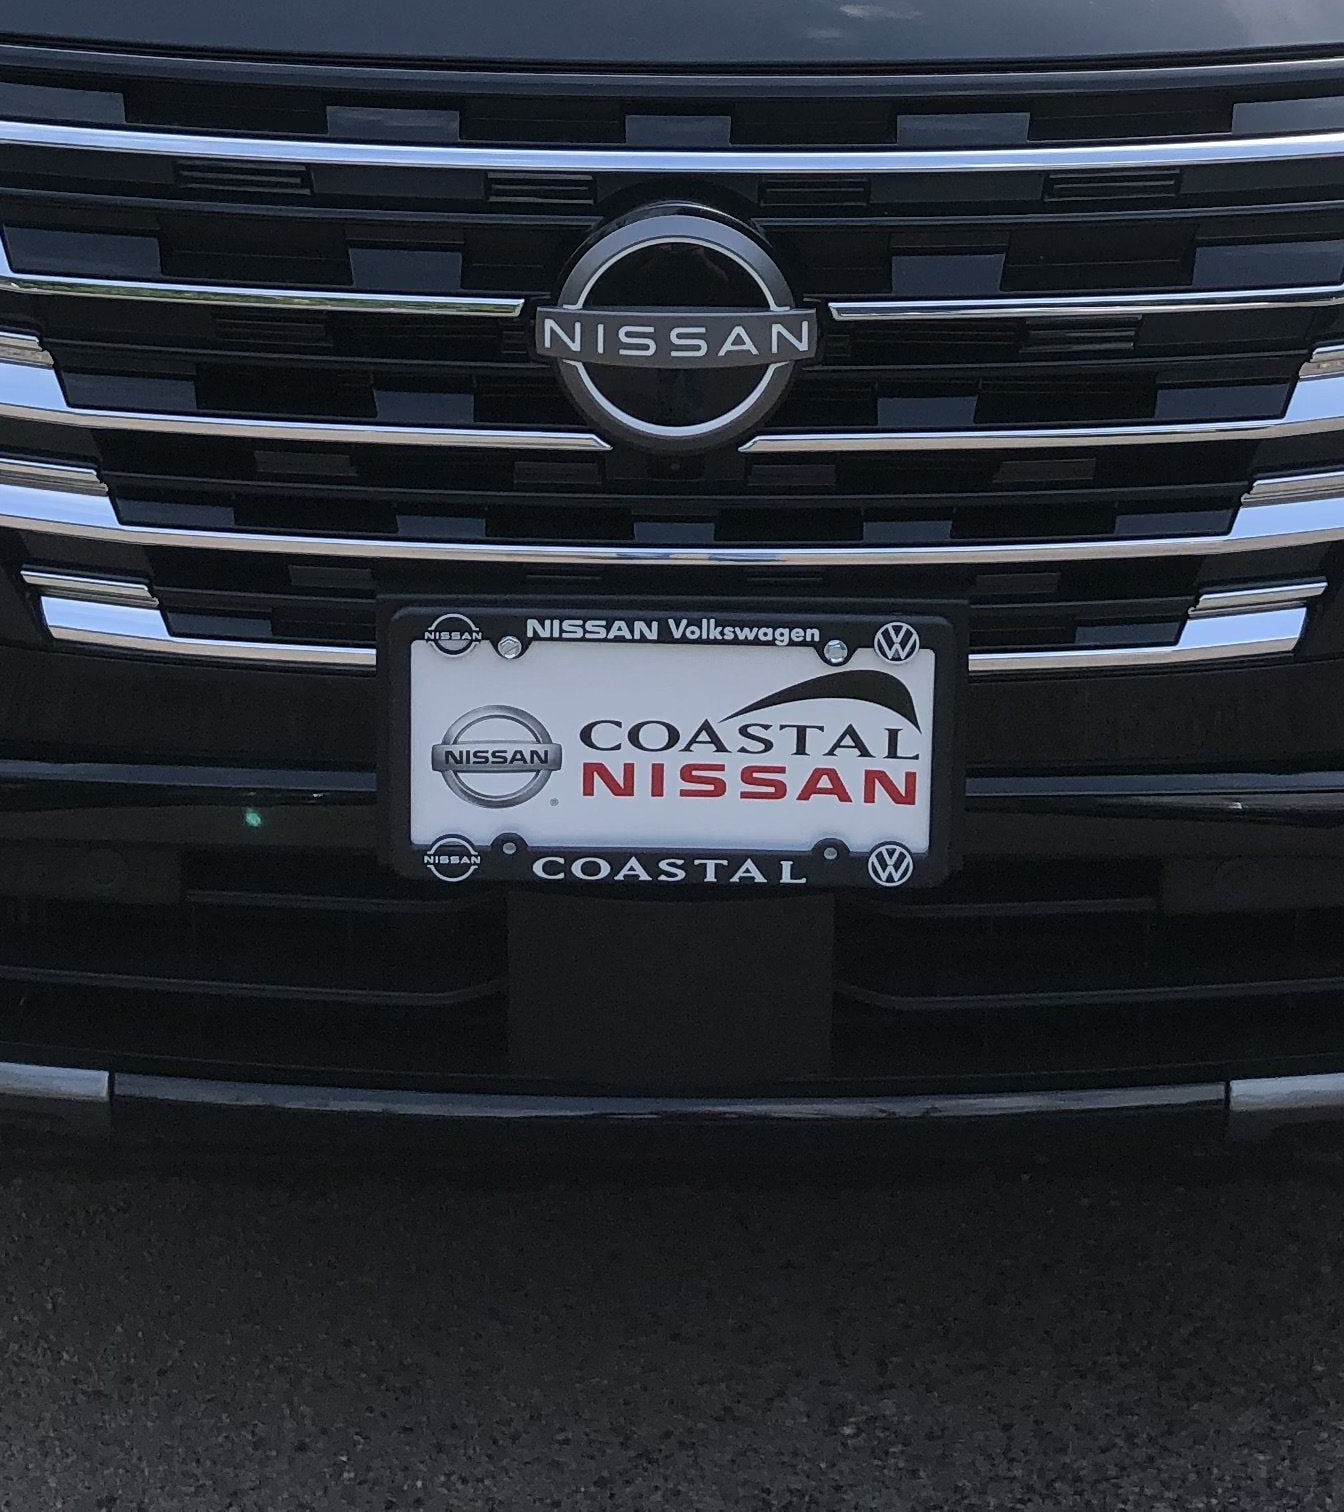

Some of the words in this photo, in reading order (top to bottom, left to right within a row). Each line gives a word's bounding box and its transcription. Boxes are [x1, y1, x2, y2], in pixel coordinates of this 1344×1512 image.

[543, 318, 809, 357] NISSAN
[424, 631, 482, 640] NISSAN
[526, 618, 659, 639] NISSAN
[667, 618, 820, 646] Volkswagen
[579, 718, 920, 761] COASTAL
[444, 749, 549, 765] NISSAN
[582, 762, 917, 805] NISSAN
[423, 855, 481, 864] NISSAN
[532, 856, 807, 884] COASTAL
